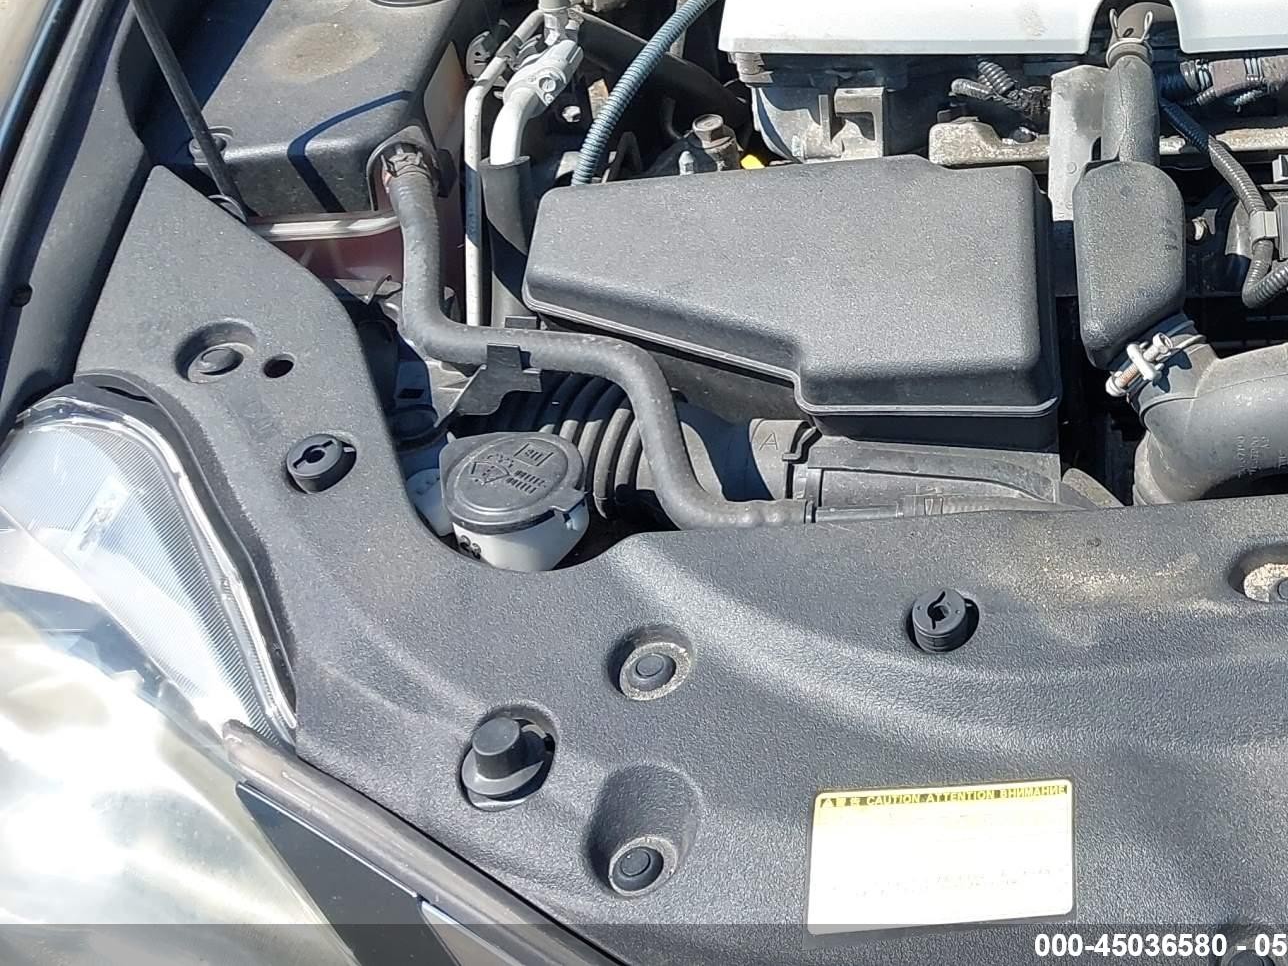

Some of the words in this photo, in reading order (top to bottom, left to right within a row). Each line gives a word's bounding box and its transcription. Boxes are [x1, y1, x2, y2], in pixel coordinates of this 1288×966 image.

[759, 432, 779, 451] A
[866, 794, 920, 805] CAUTION
[926, 790, 995, 803] ATTENTION
[1000, 785, 1066, 798] ВНИМАНИЕ
